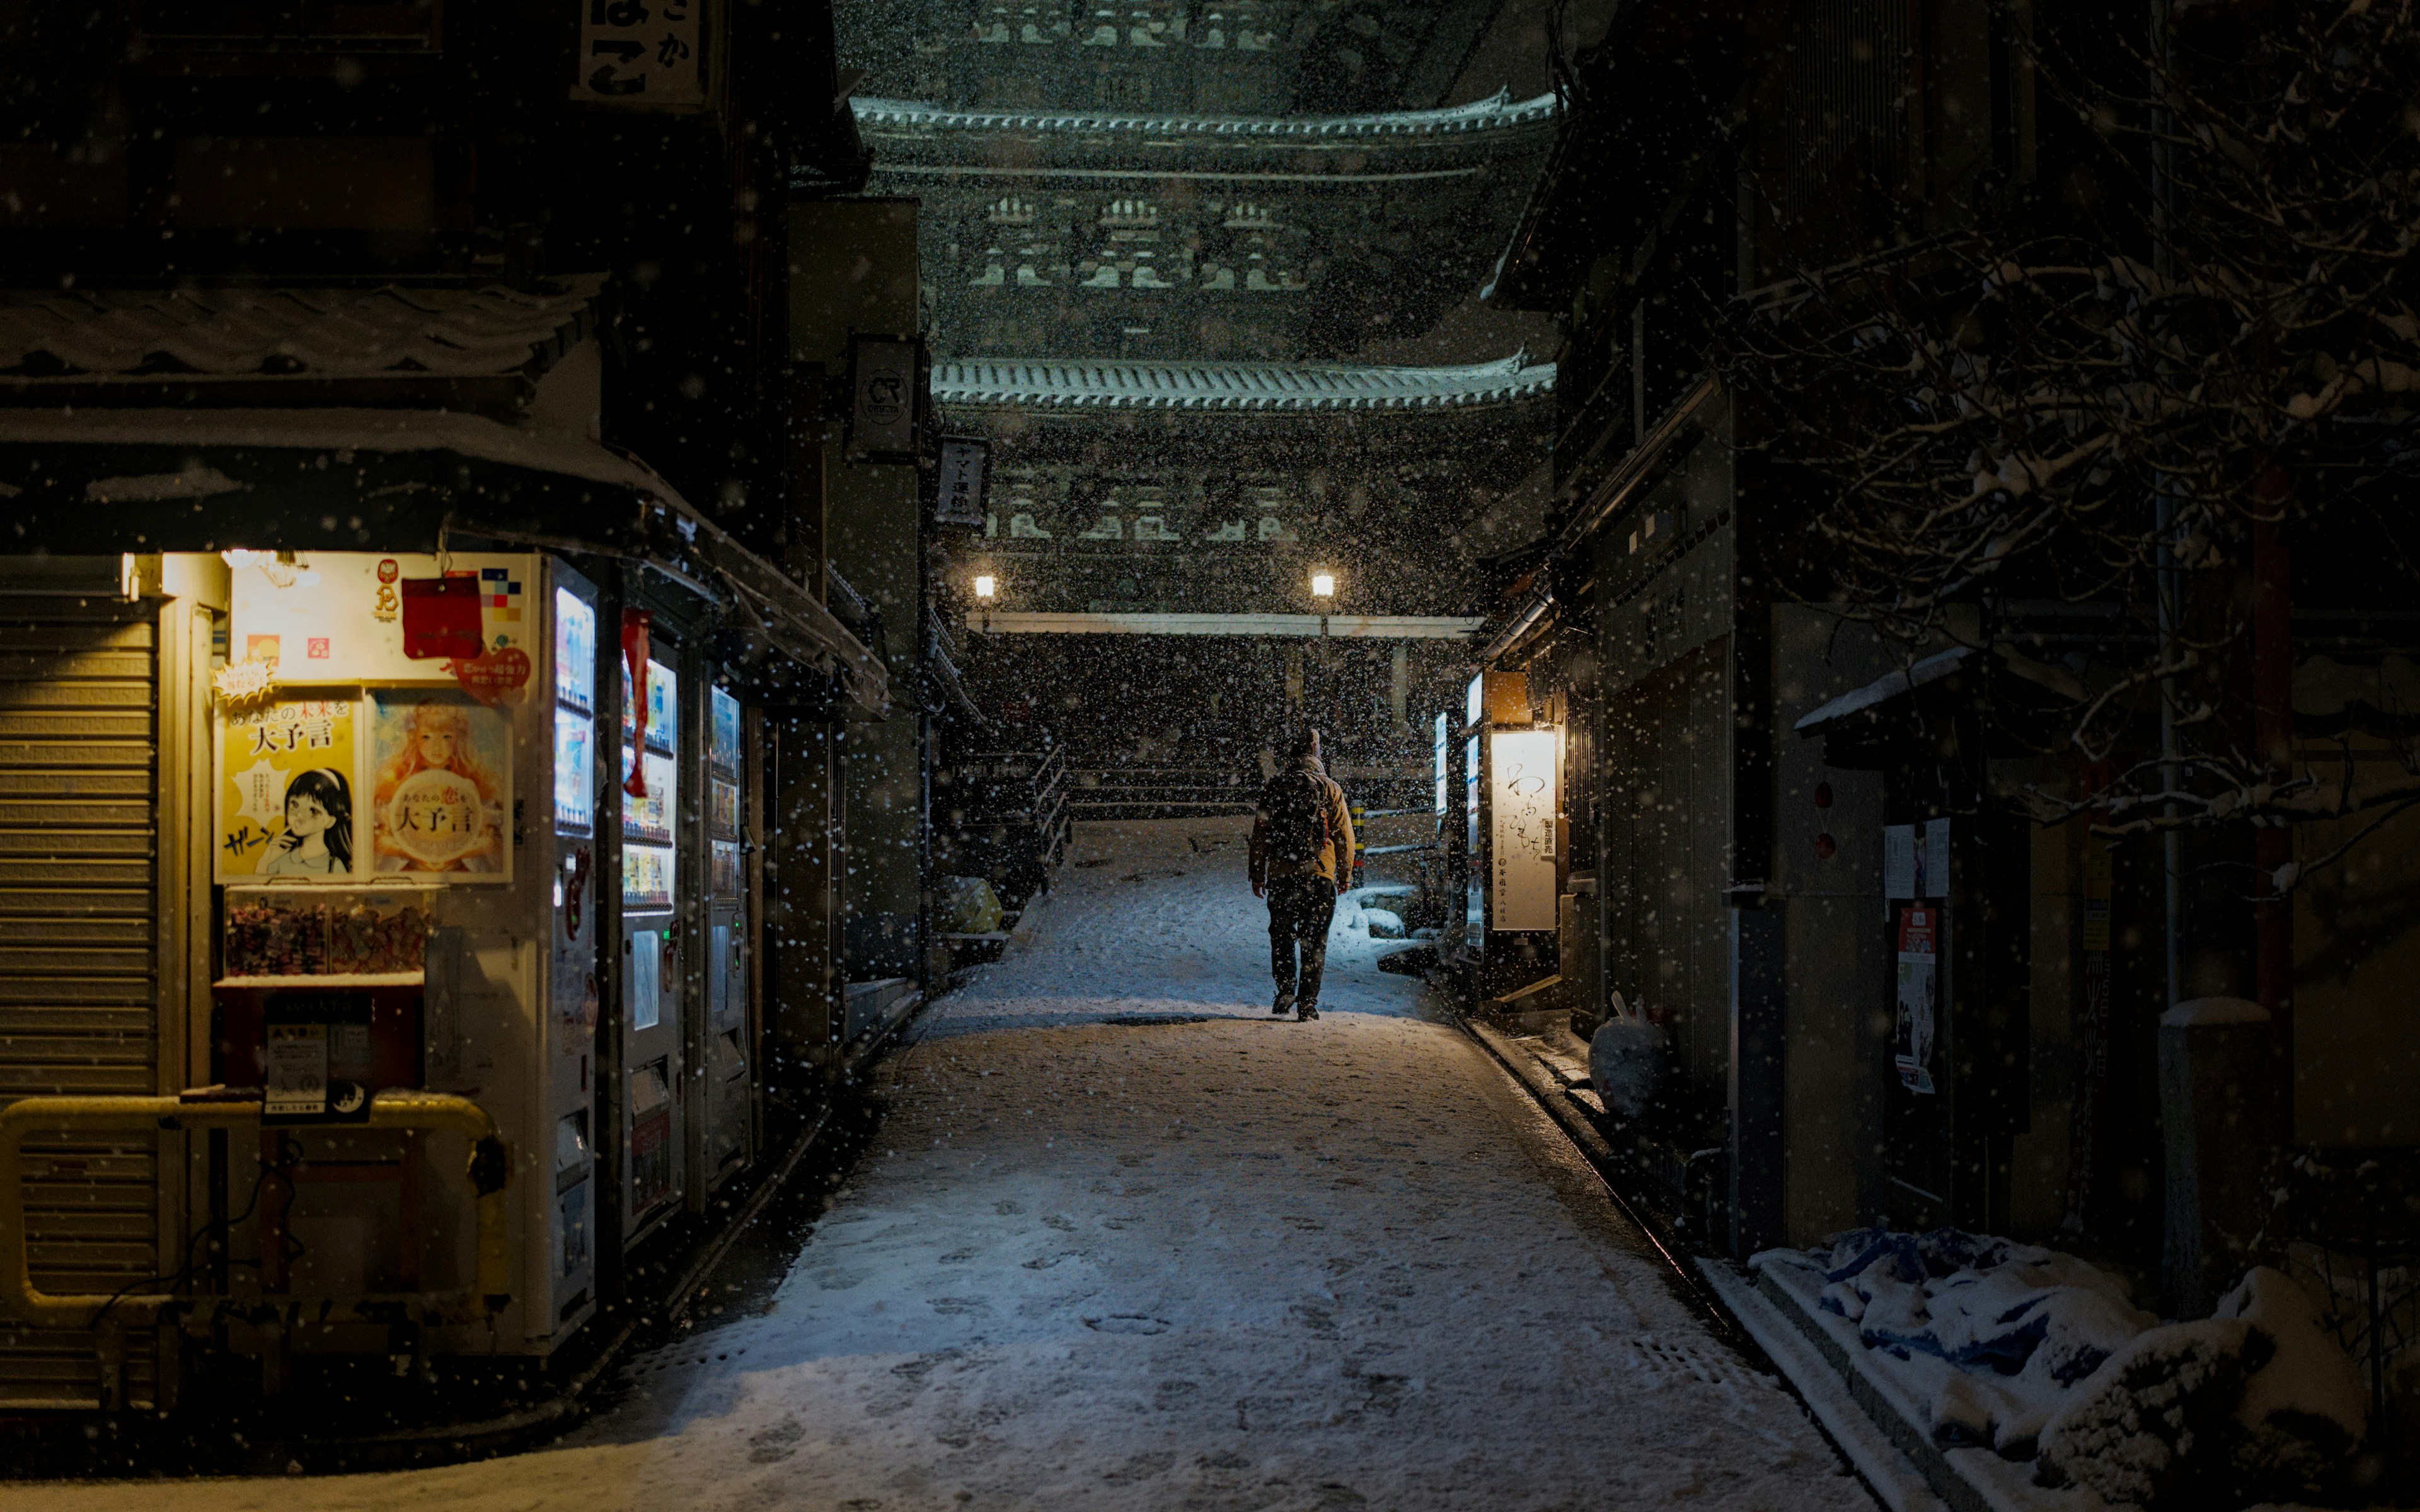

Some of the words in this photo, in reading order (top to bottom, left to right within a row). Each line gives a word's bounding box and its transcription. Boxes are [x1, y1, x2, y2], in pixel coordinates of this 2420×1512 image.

[230, 699, 349, 726] あなたの未来を
[250, 718, 333, 755] 大予言
[403, 786, 468, 805] あなたの恋を
[396, 806, 474, 833] 大予言
[224, 826, 275, 857] ザーン
[1544, 820, 1553, 854] 製造直売
